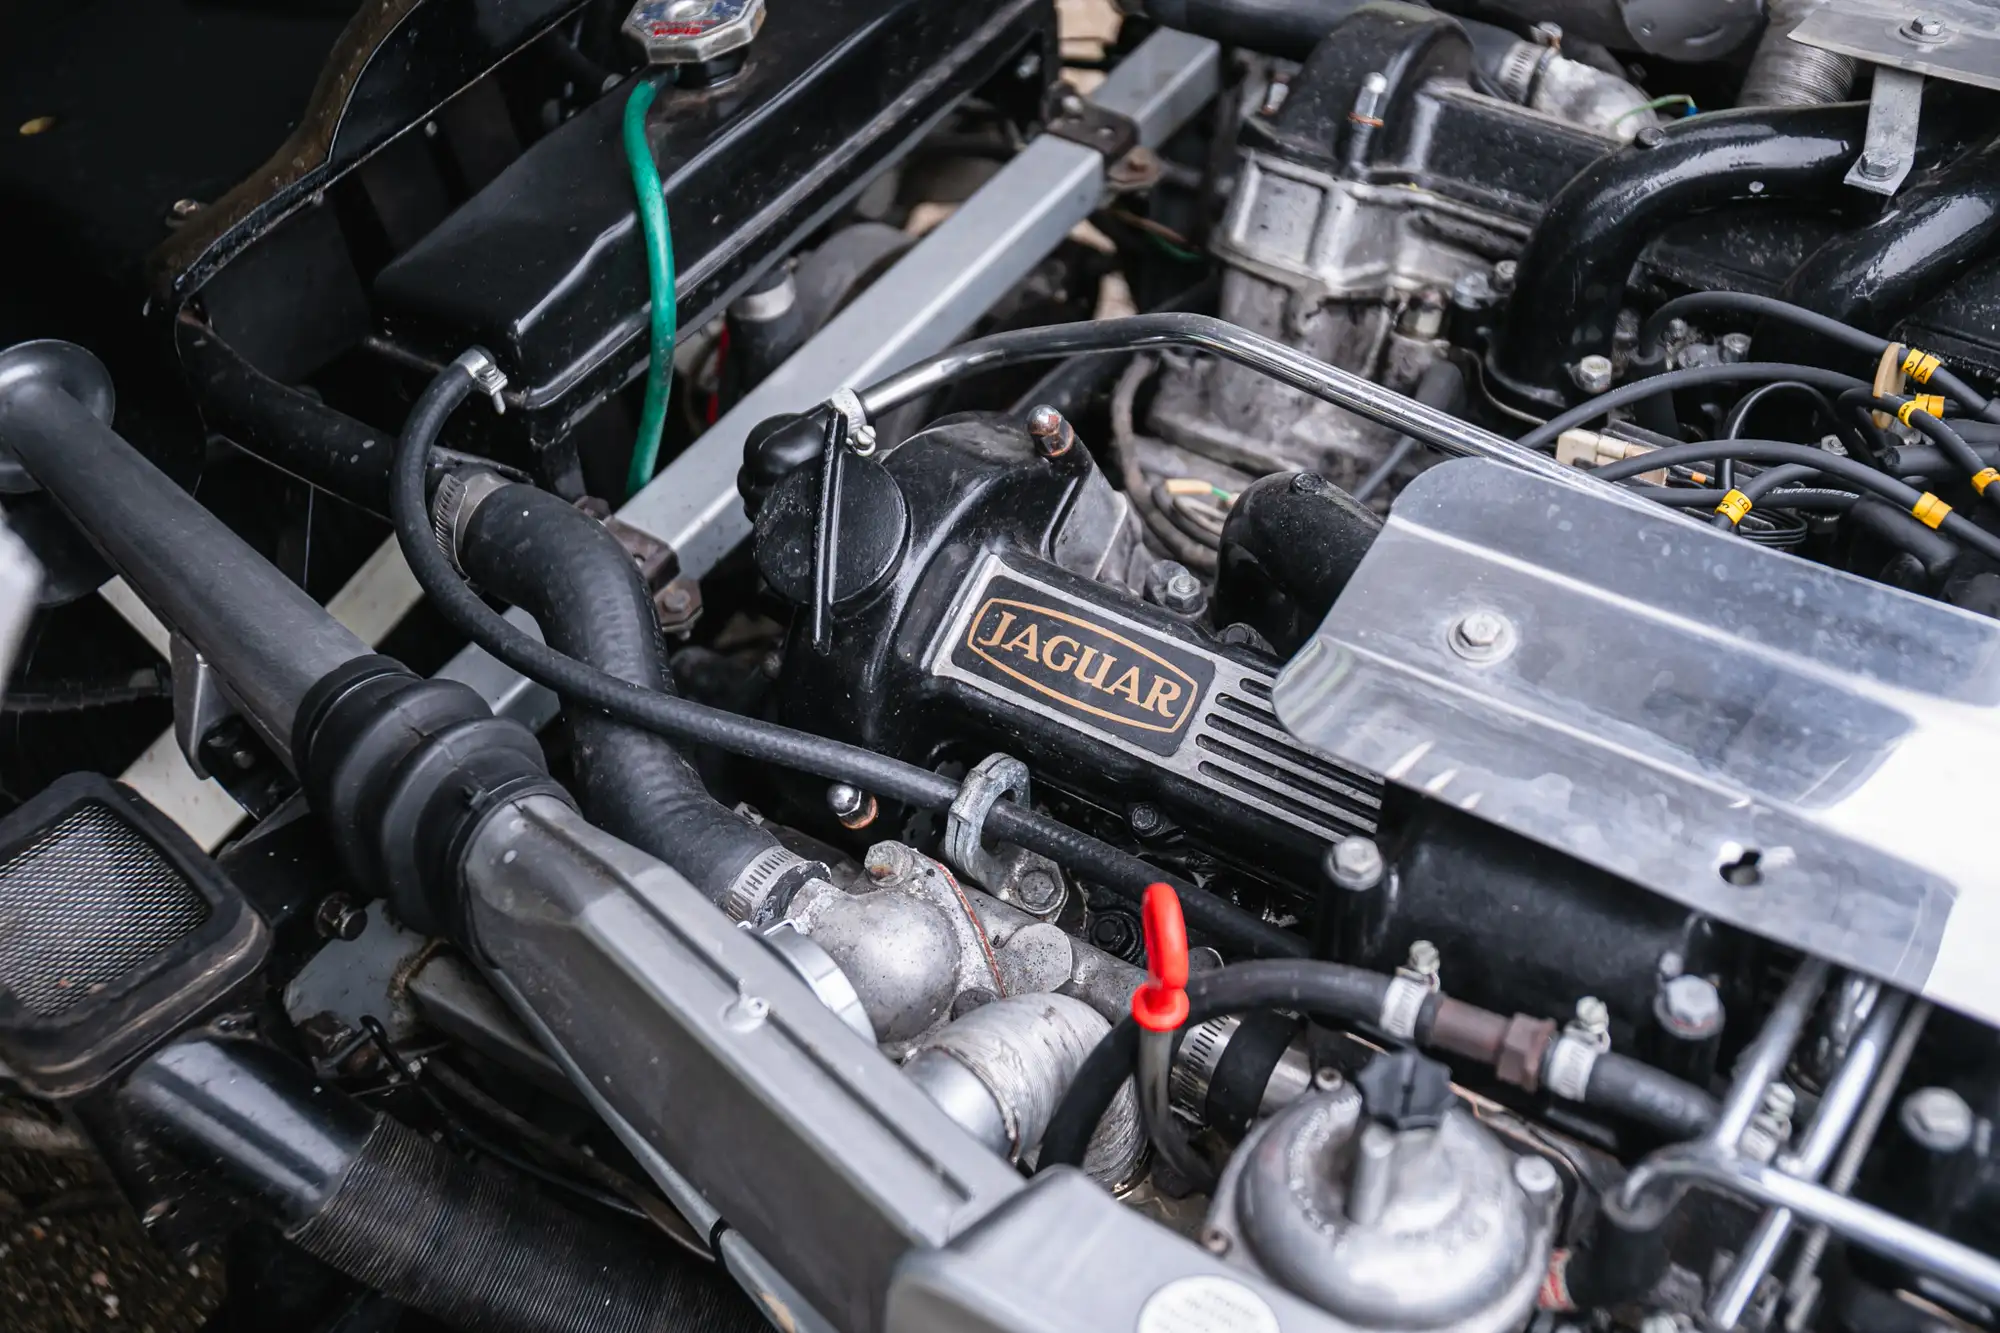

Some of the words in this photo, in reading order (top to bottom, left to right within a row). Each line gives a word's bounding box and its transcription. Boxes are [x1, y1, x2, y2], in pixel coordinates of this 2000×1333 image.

[1905, 361, 1915, 373] 2
[1918, 367, 1929, 381] A
[1772, 487, 1842, 496] TEMPERATURE
[1737, 497, 1750, 511] B
[976, 610, 1182, 719] JAGUAR
